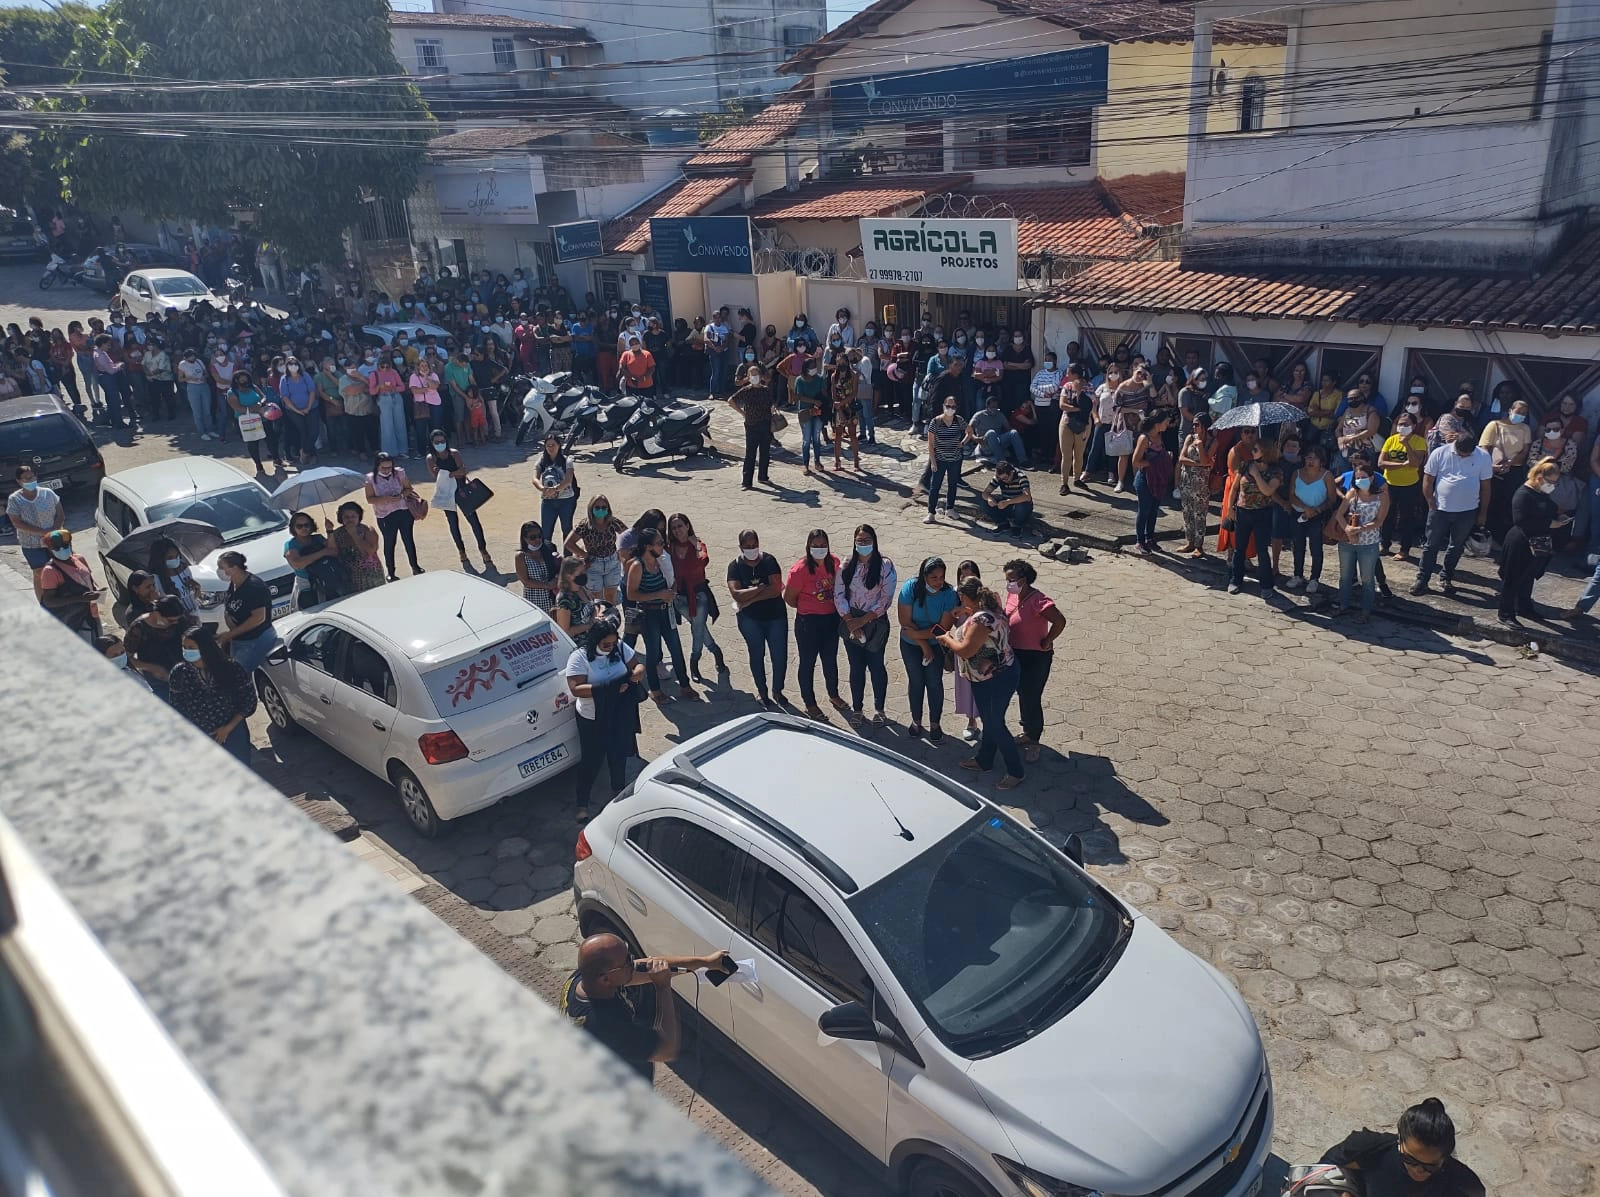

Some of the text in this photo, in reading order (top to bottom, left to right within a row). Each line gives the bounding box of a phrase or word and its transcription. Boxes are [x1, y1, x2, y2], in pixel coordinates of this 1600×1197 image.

[867, 94, 957, 116] CONVIVENDO
[873, 220, 997, 254] AGRÍCOLA
[688, 241, 749, 257] CONVIVENDO
[940, 256, 999, 269] PROJETOS
[869, 269, 923, 282] 27 99978-2707
[1144, 331, 1157, 341] 77
[500, 631, 559, 660] SINDSERV
